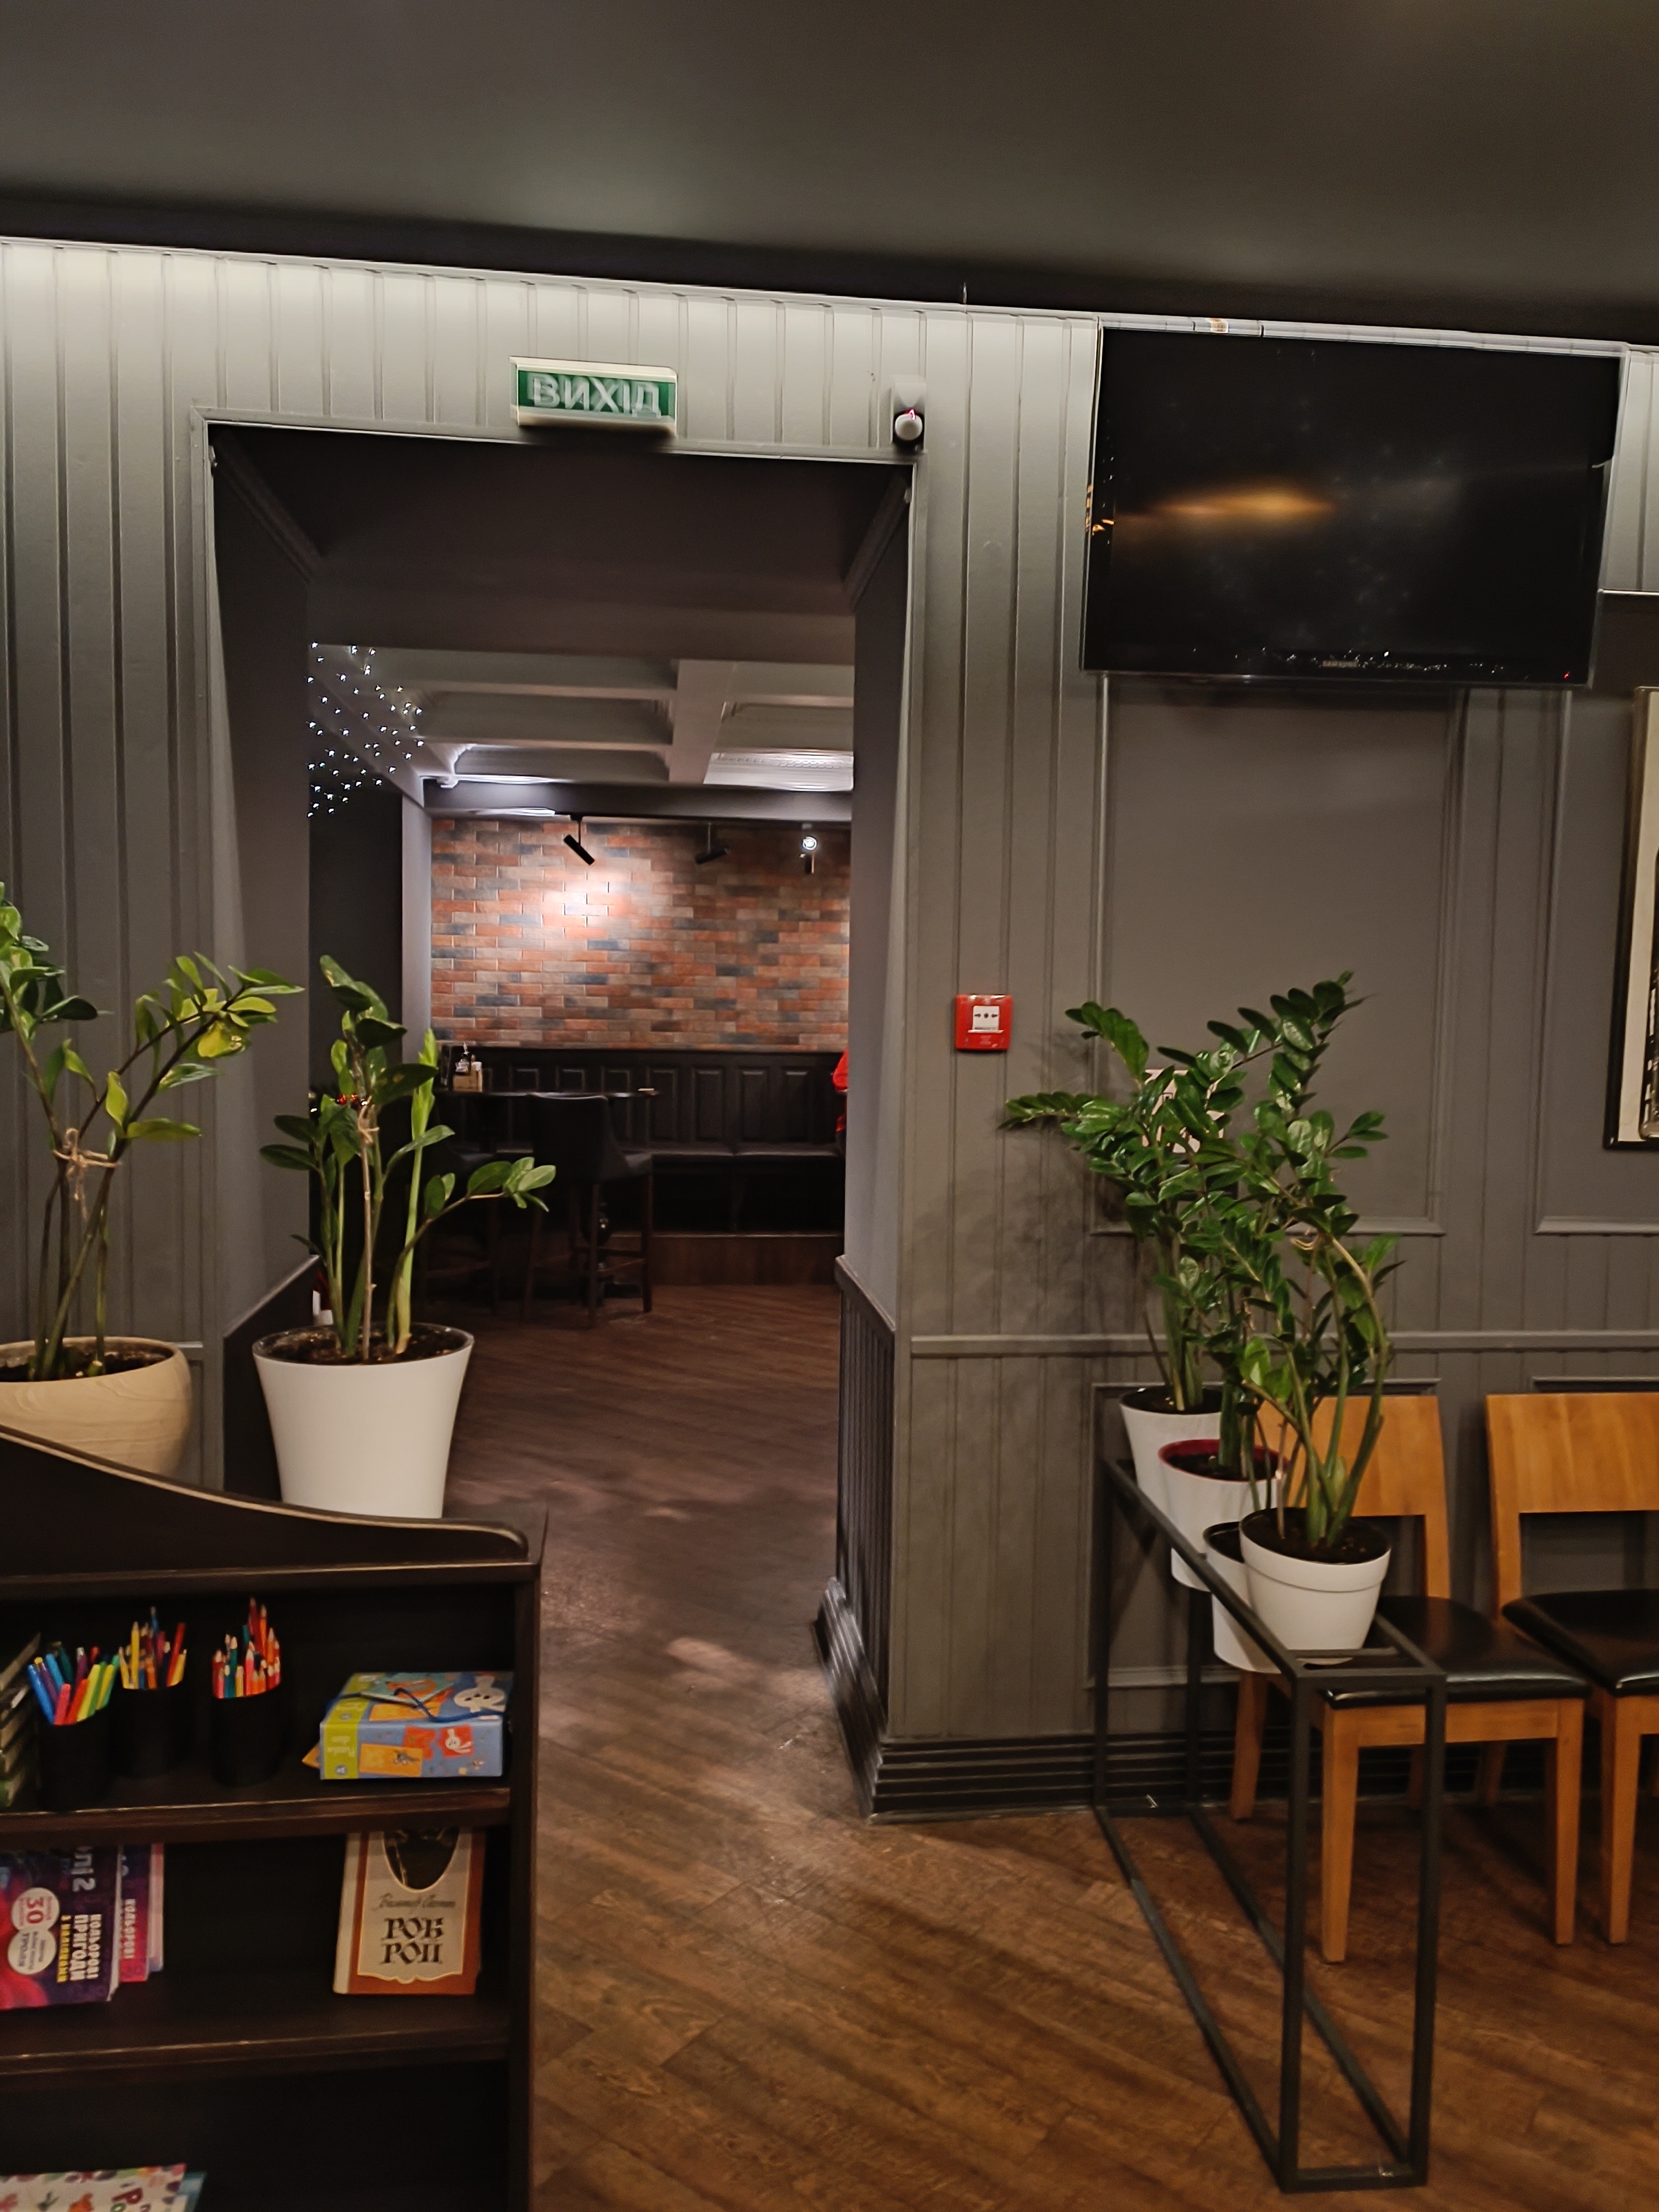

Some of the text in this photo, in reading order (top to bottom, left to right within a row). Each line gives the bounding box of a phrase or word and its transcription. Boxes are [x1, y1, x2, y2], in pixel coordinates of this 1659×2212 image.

[531, 374, 662, 419] ВИХІД
[72, 1878, 96, 1892] 2
[27, 1897, 44, 1923] 30
[69, 1914, 88, 1981] ПРИГОДИ
[87, 1914, 102, 1979] КОЛЬОРОВІ
